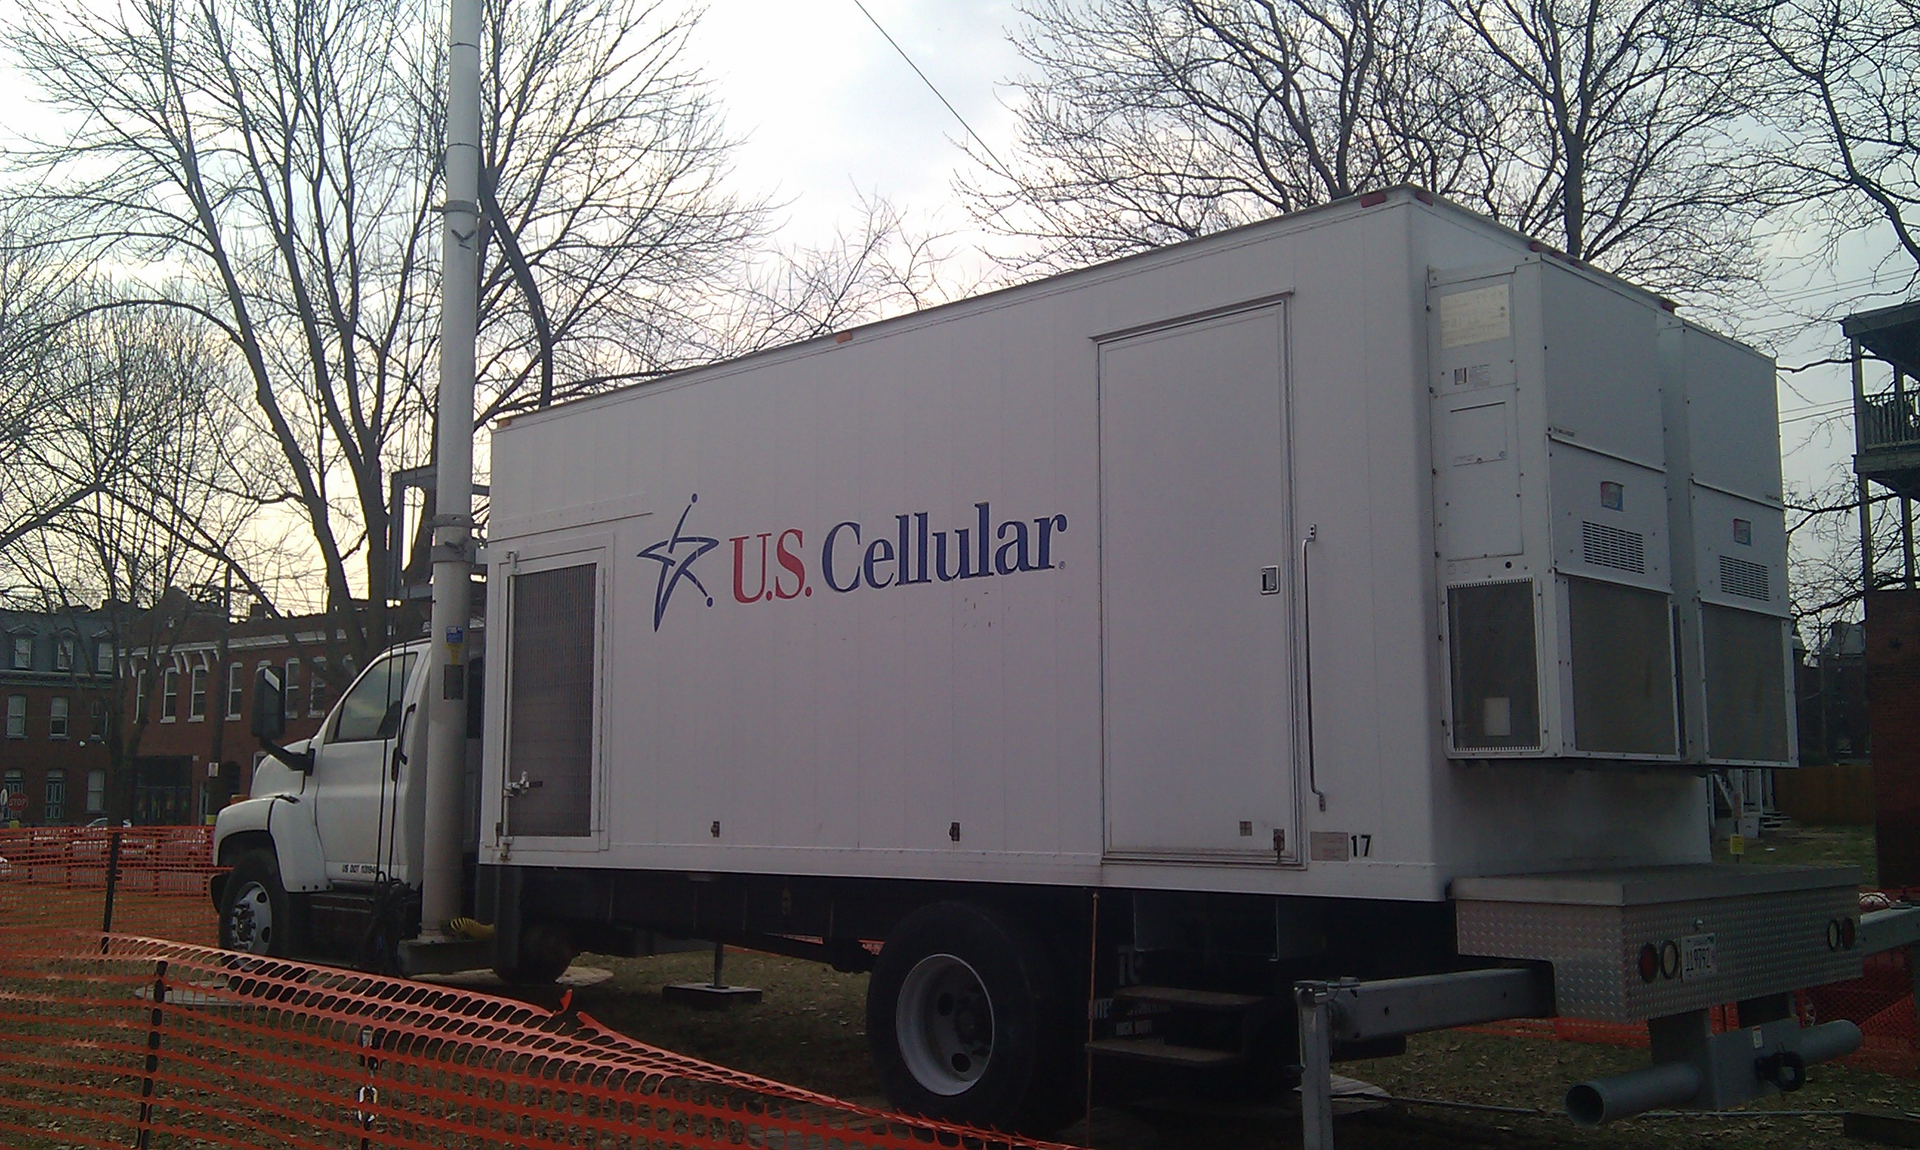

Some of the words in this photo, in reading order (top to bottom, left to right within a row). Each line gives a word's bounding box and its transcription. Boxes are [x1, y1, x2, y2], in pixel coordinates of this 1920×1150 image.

[729, 528, 812, 604] U.S.
[9, 798, 26, 807] STOP
[1351, 834, 1371, 857] 17
